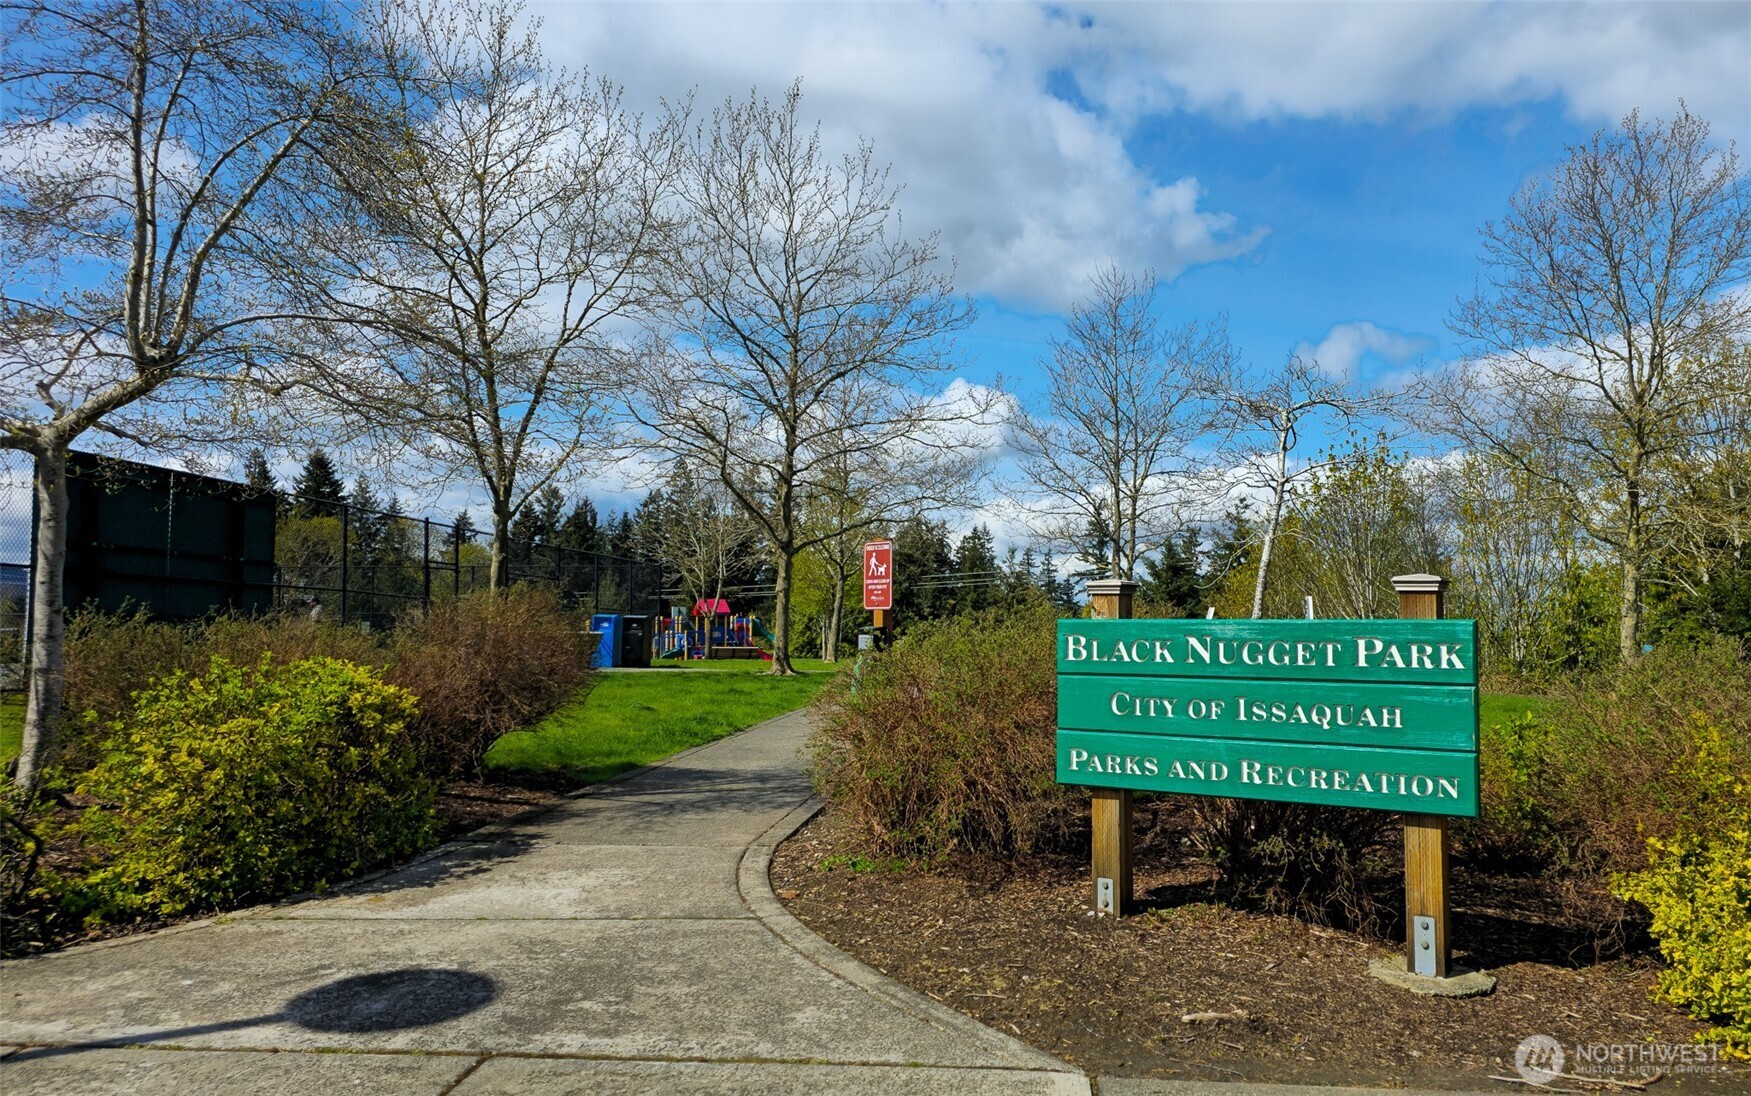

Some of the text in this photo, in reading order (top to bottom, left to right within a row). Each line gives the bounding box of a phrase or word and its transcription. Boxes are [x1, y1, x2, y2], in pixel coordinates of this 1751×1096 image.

[1065, 634, 1466, 670] BLACK NUGGET PARK
[1110, 691, 1404, 730] CITY OF ISSAQUAH
[1068, 747, 1460, 799] PARKS AND RECREATION
